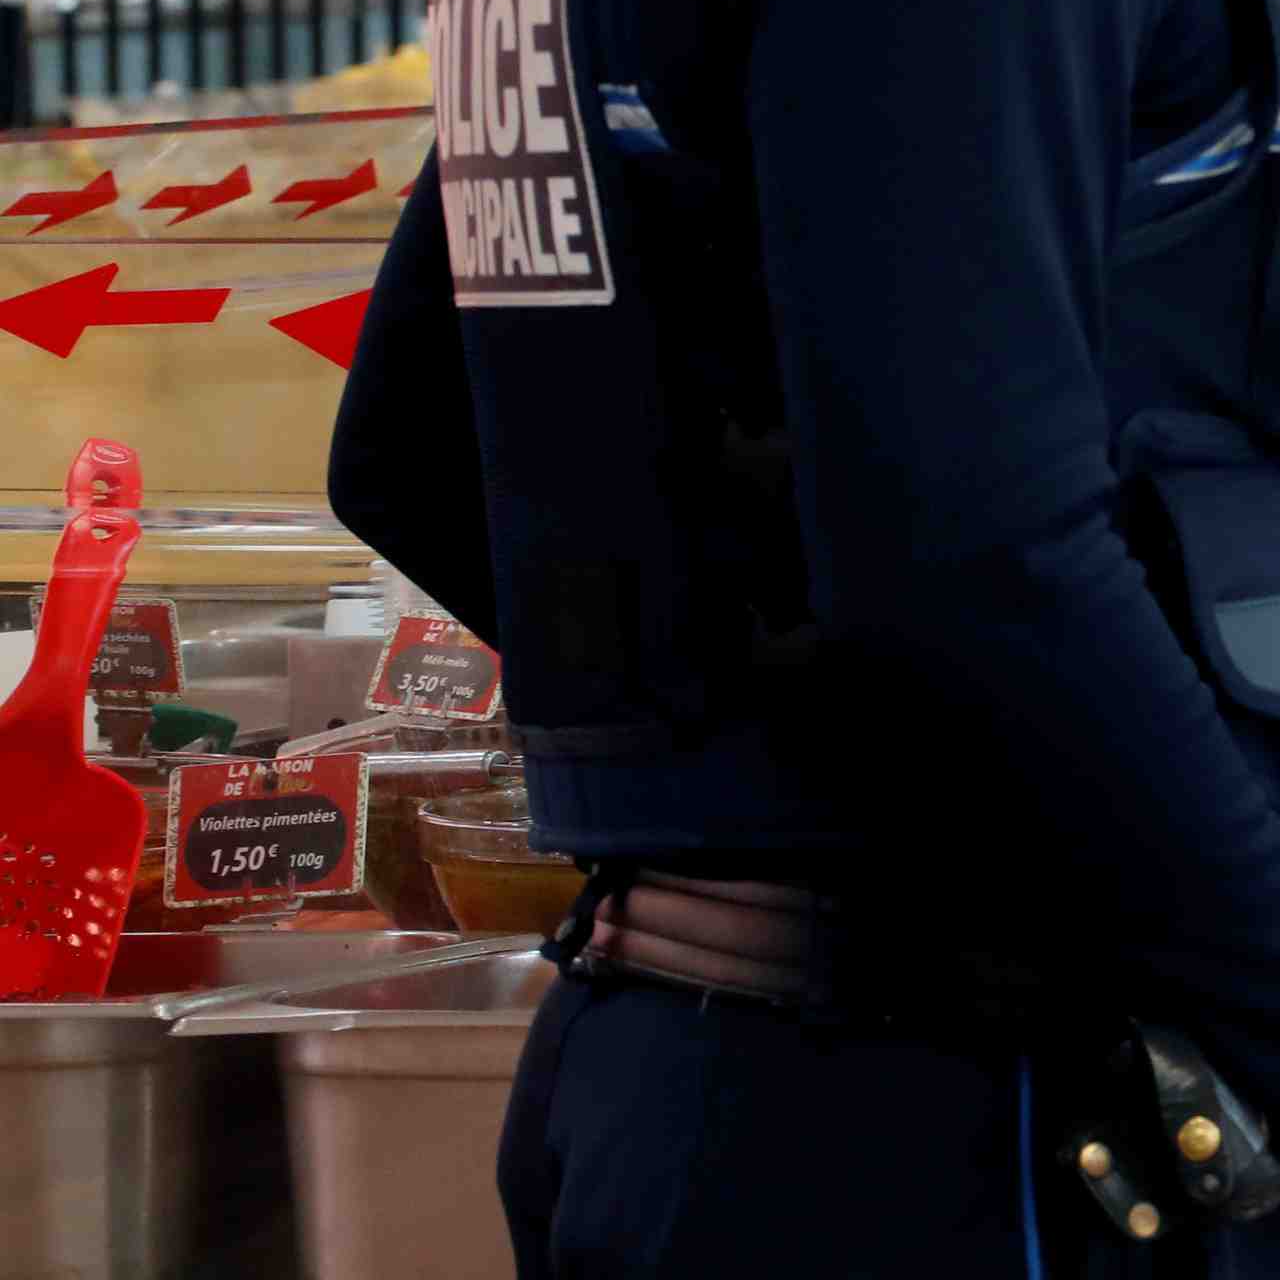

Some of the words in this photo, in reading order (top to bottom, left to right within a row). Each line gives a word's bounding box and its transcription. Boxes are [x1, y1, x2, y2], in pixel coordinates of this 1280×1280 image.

[228, 764, 250, 779] LA
[224, 781, 246, 797] DE
[200, 816, 260, 832] Violettes
[262, 809, 337, 831] pimentées
[209, 843, 281, 877] 1,50€
[288, 852, 324, 870] 100g
